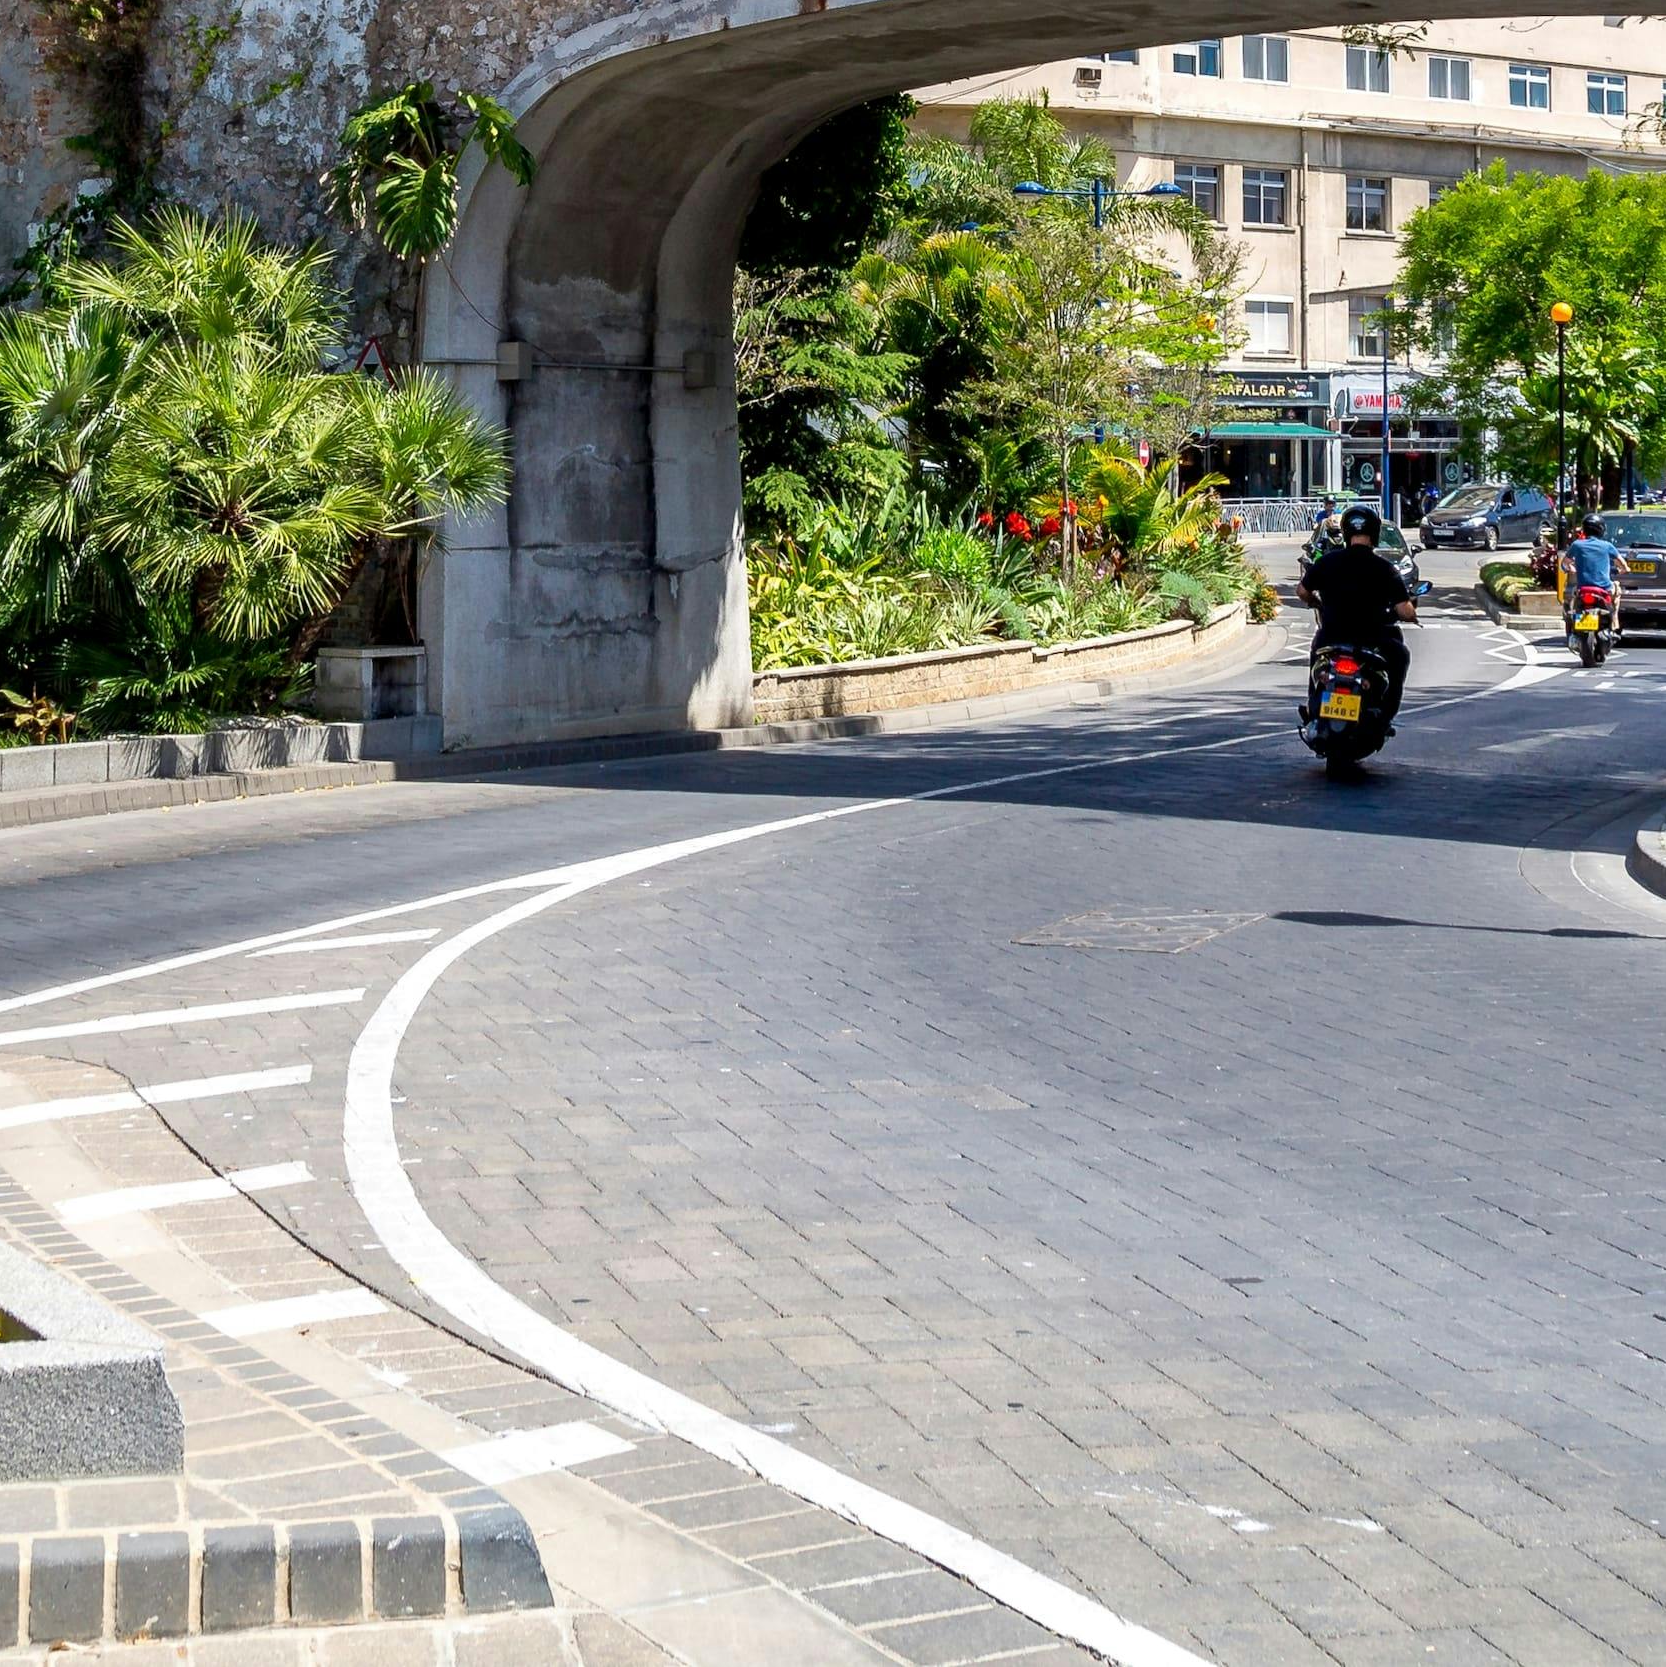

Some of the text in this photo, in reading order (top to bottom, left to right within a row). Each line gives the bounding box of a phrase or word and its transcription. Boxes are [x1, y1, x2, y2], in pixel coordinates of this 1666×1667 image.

[1364, 393, 1402, 408] YAMHA
[1336, 696, 1343, 705] G
[1349, 709, 1356, 717] C
